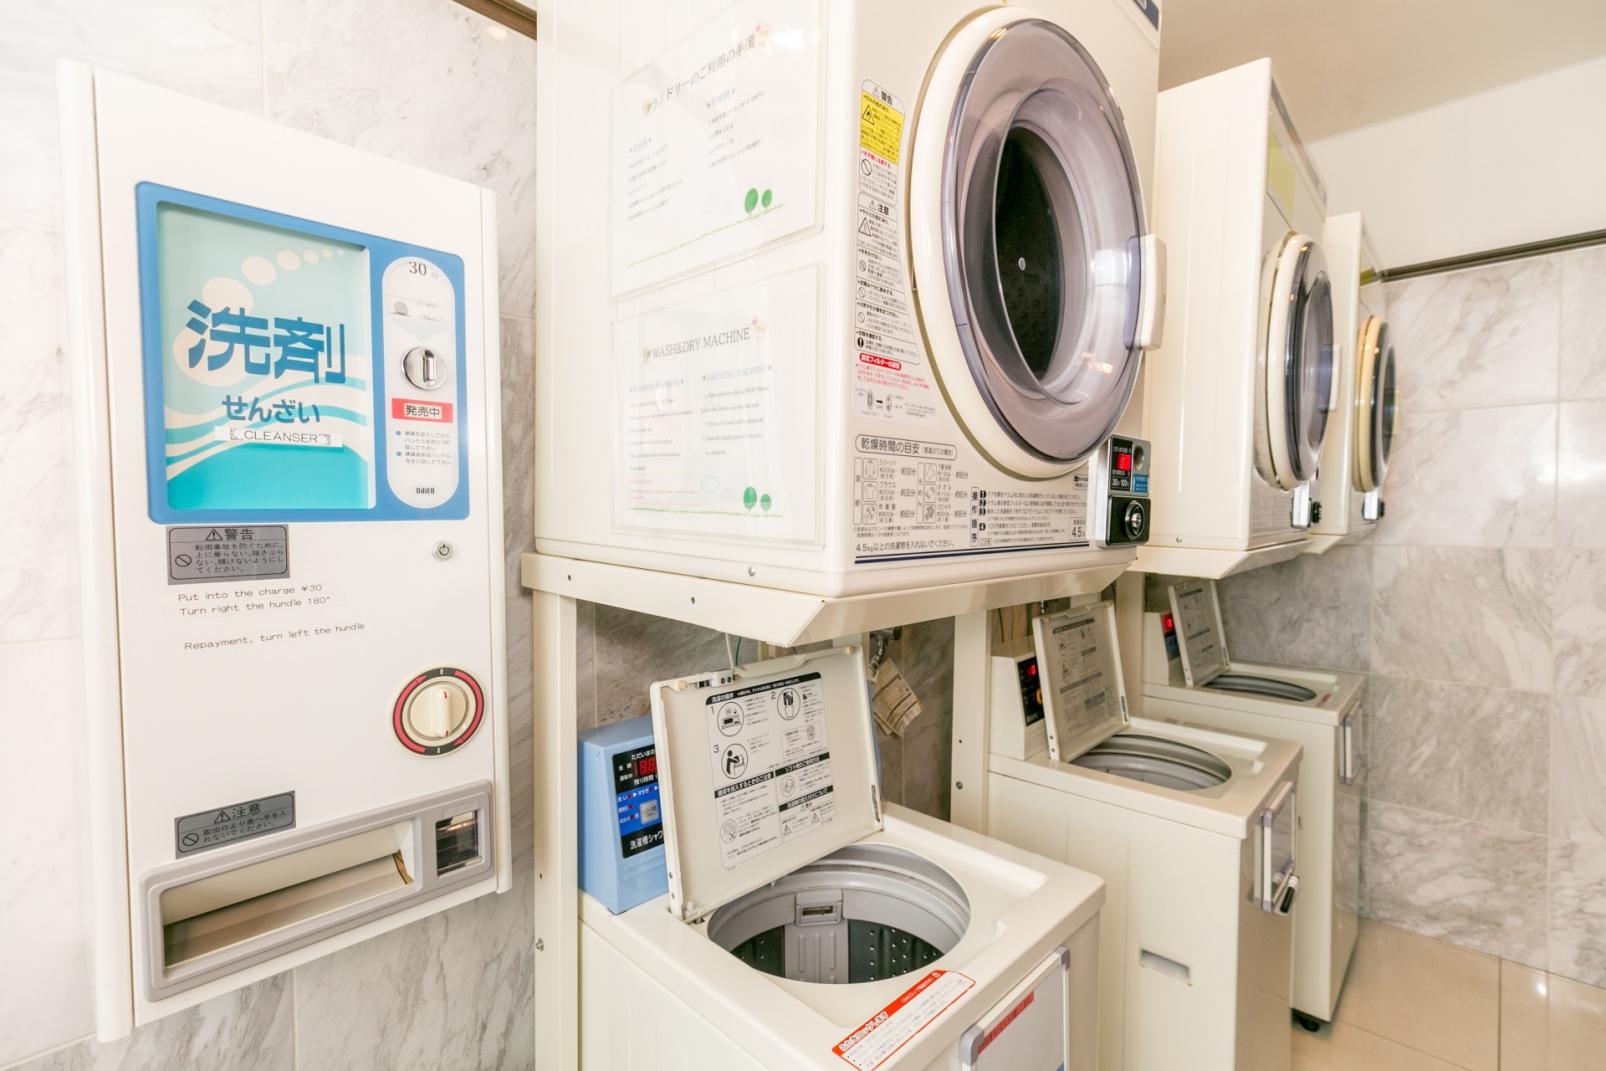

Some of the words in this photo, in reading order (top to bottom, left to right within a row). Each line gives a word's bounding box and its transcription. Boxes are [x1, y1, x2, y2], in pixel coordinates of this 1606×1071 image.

[408, 261, 427, 276] 30
[187, 299, 346, 384] 洗剤
[652, 337, 701, 360] WASH&DRY
[703, 327, 750, 349] MACHINE
[222, 395, 320, 423] せんざい
[405, 405, 440, 417] 発売中
[244, 430, 319, 444] CLEANSER
[861, 438, 920, 455] 乾燥時間の目安
[224, 528, 254, 540] 警告
[178, 593, 199, 602] Put
[205, 592, 228, 600] into
[258, 586, 295, 596] charge
[301, 584, 322, 592] ¥30
[180, 608, 206, 616] Turn
[212, 604, 239, 614] right
[246, 602, 264, 611] the
[269, 599, 302, 608] hundle
[308, 596, 331, 605] 180°
[184, 636, 253, 650] Repayment,
[260, 633, 283, 642] turn
[288, 629, 309, 638] left
[335, 623, 365, 632] hundle
[771, 691, 776, 700] 2
[713, 744, 719, 753] 3
[232, 803, 261, 818] 注意
